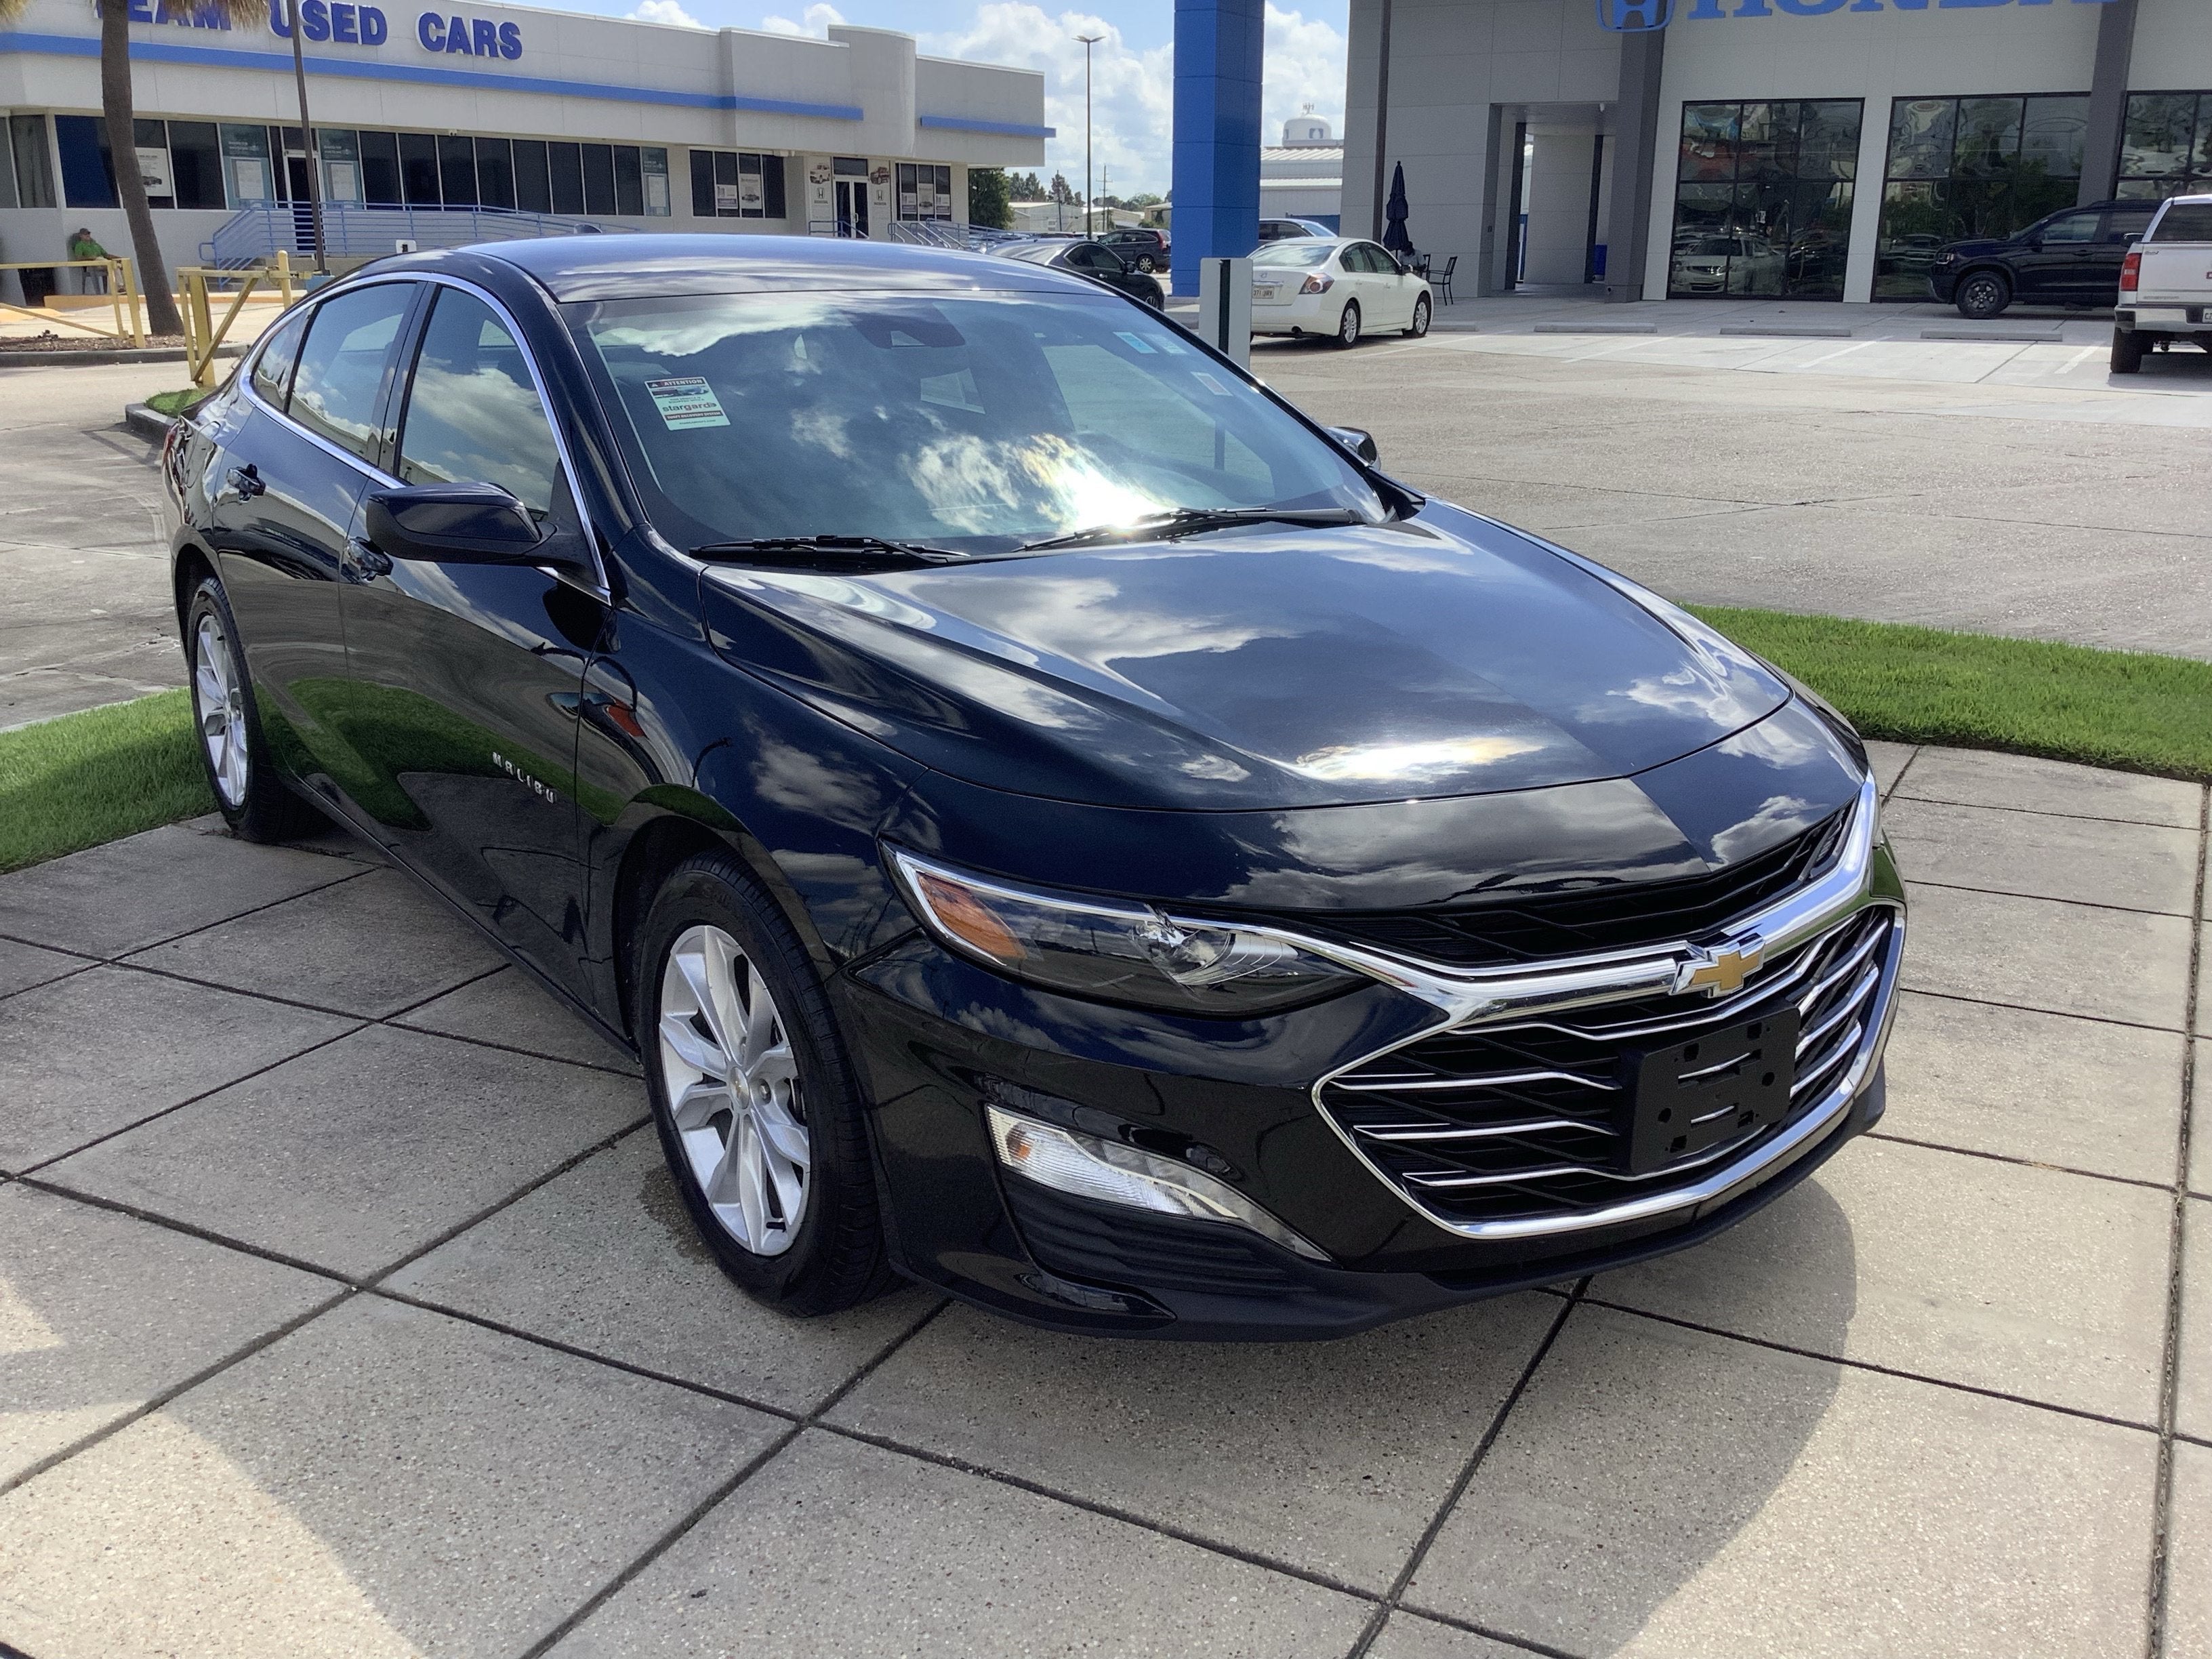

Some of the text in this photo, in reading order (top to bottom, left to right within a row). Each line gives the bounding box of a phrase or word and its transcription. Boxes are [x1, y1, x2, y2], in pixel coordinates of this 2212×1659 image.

[96, 0, 523, 60] EAM USED CARS
[493, 752, 554, 804] MALIBU
